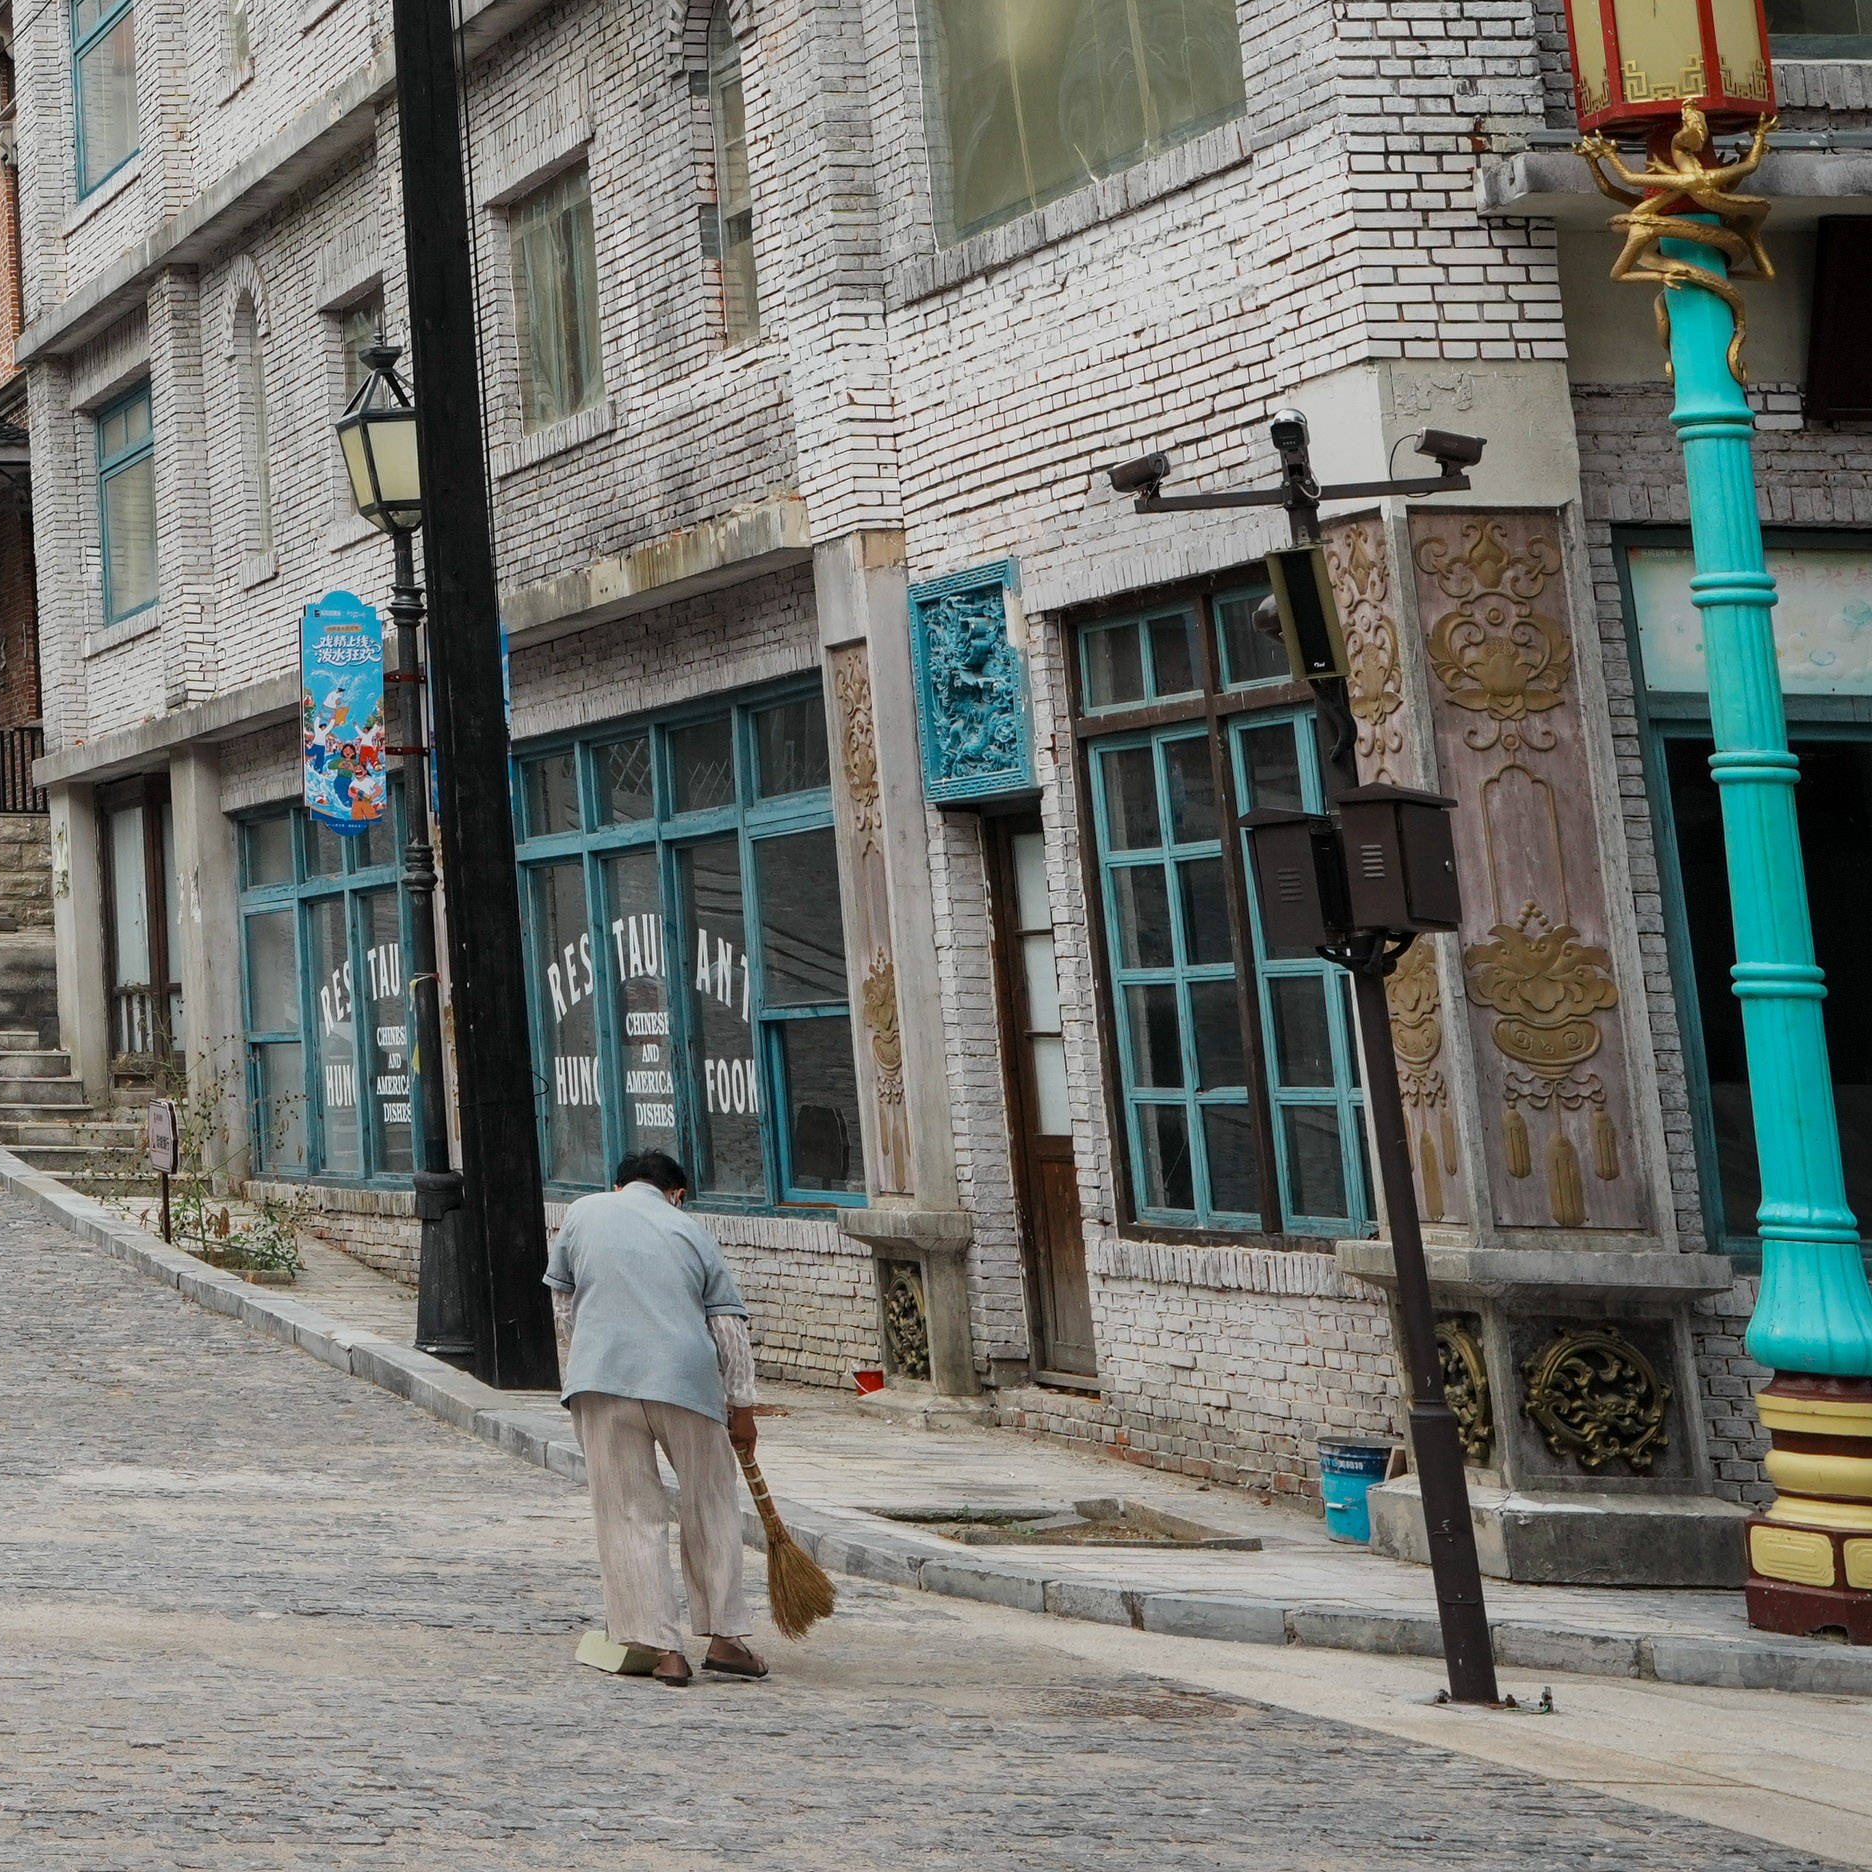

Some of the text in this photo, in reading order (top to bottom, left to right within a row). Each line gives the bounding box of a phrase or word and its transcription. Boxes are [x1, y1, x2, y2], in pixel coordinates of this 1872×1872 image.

[312, 634, 371, 649] 戏精上线
[316, 647, 382, 666] 泼水狂欢
[547, 913, 750, 1025] RESTAUANT
[388, 1052, 402, 1069] AND
[642, 1043, 660, 1063] AND
[625, 1070, 675, 1095] AMERICA
[383, 1102, 412, 1124] DISHES
[635, 1102, 676, 1128] DISHES
